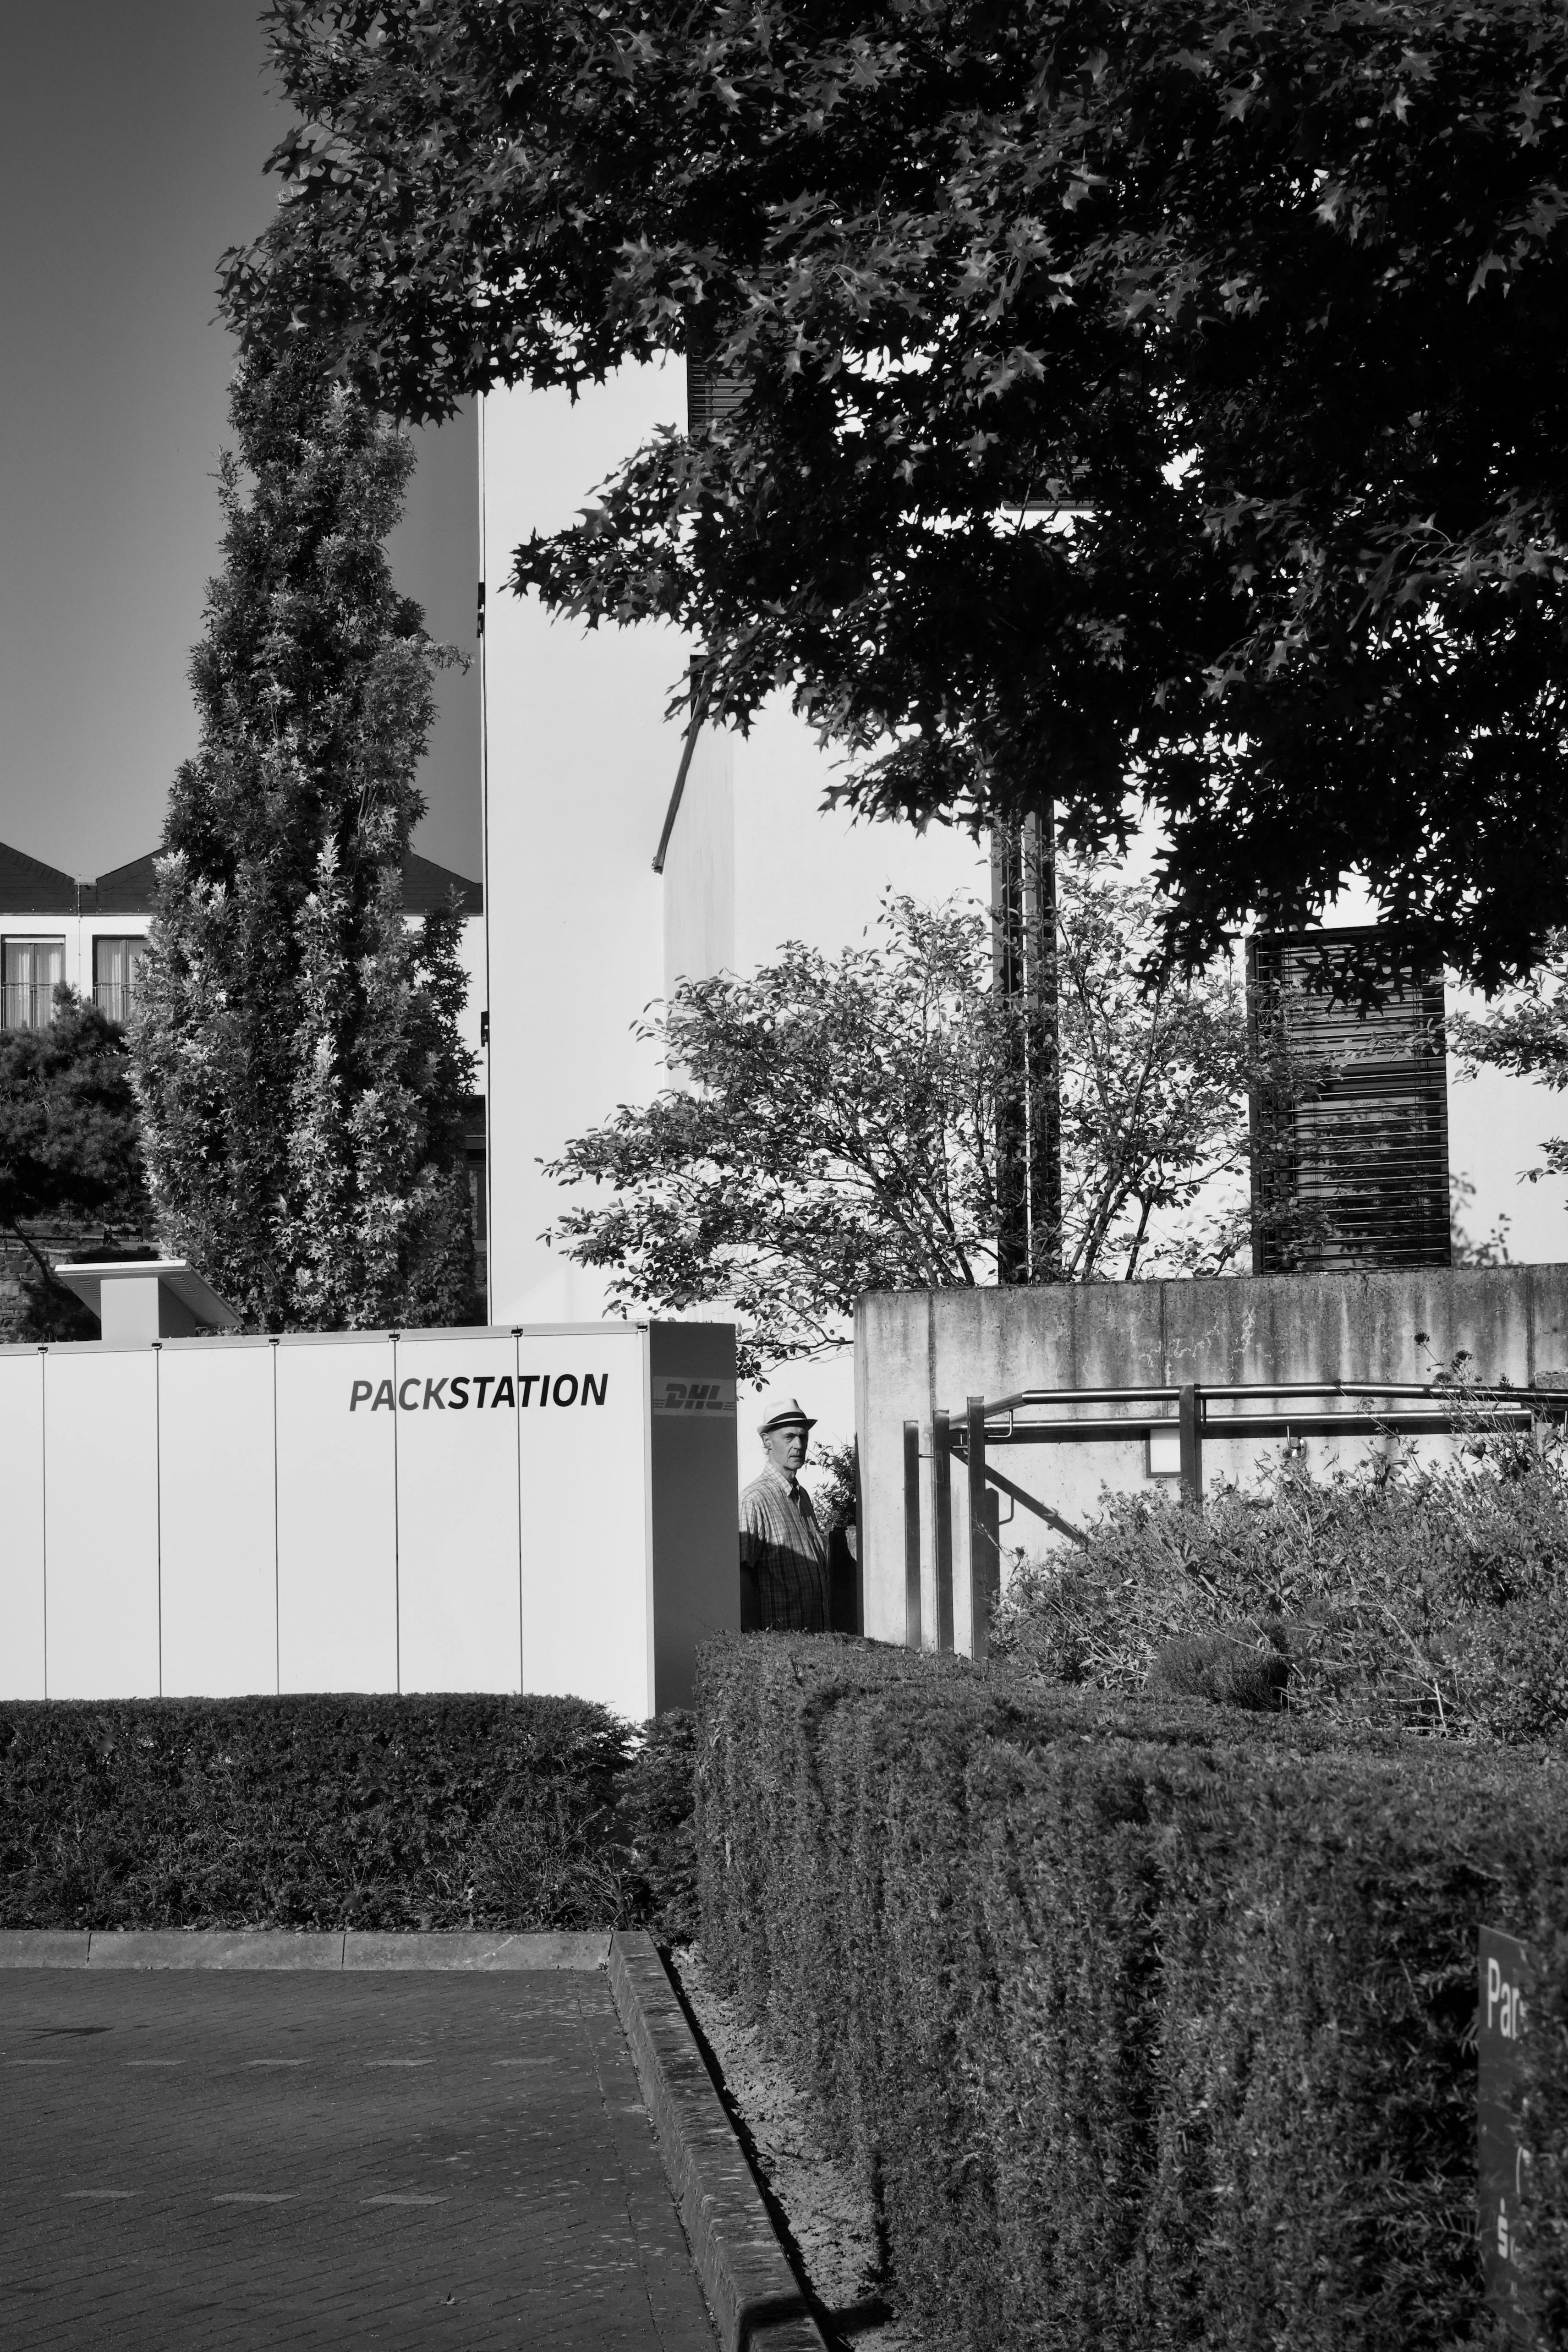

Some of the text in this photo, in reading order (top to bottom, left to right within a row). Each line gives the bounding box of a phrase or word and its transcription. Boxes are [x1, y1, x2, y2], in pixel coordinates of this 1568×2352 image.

[349, 1373, 609, 1412] PACKSTATION
[664, 1383, 724, 1410] DHL
[1487, 1957, 1526, 2041] Par
